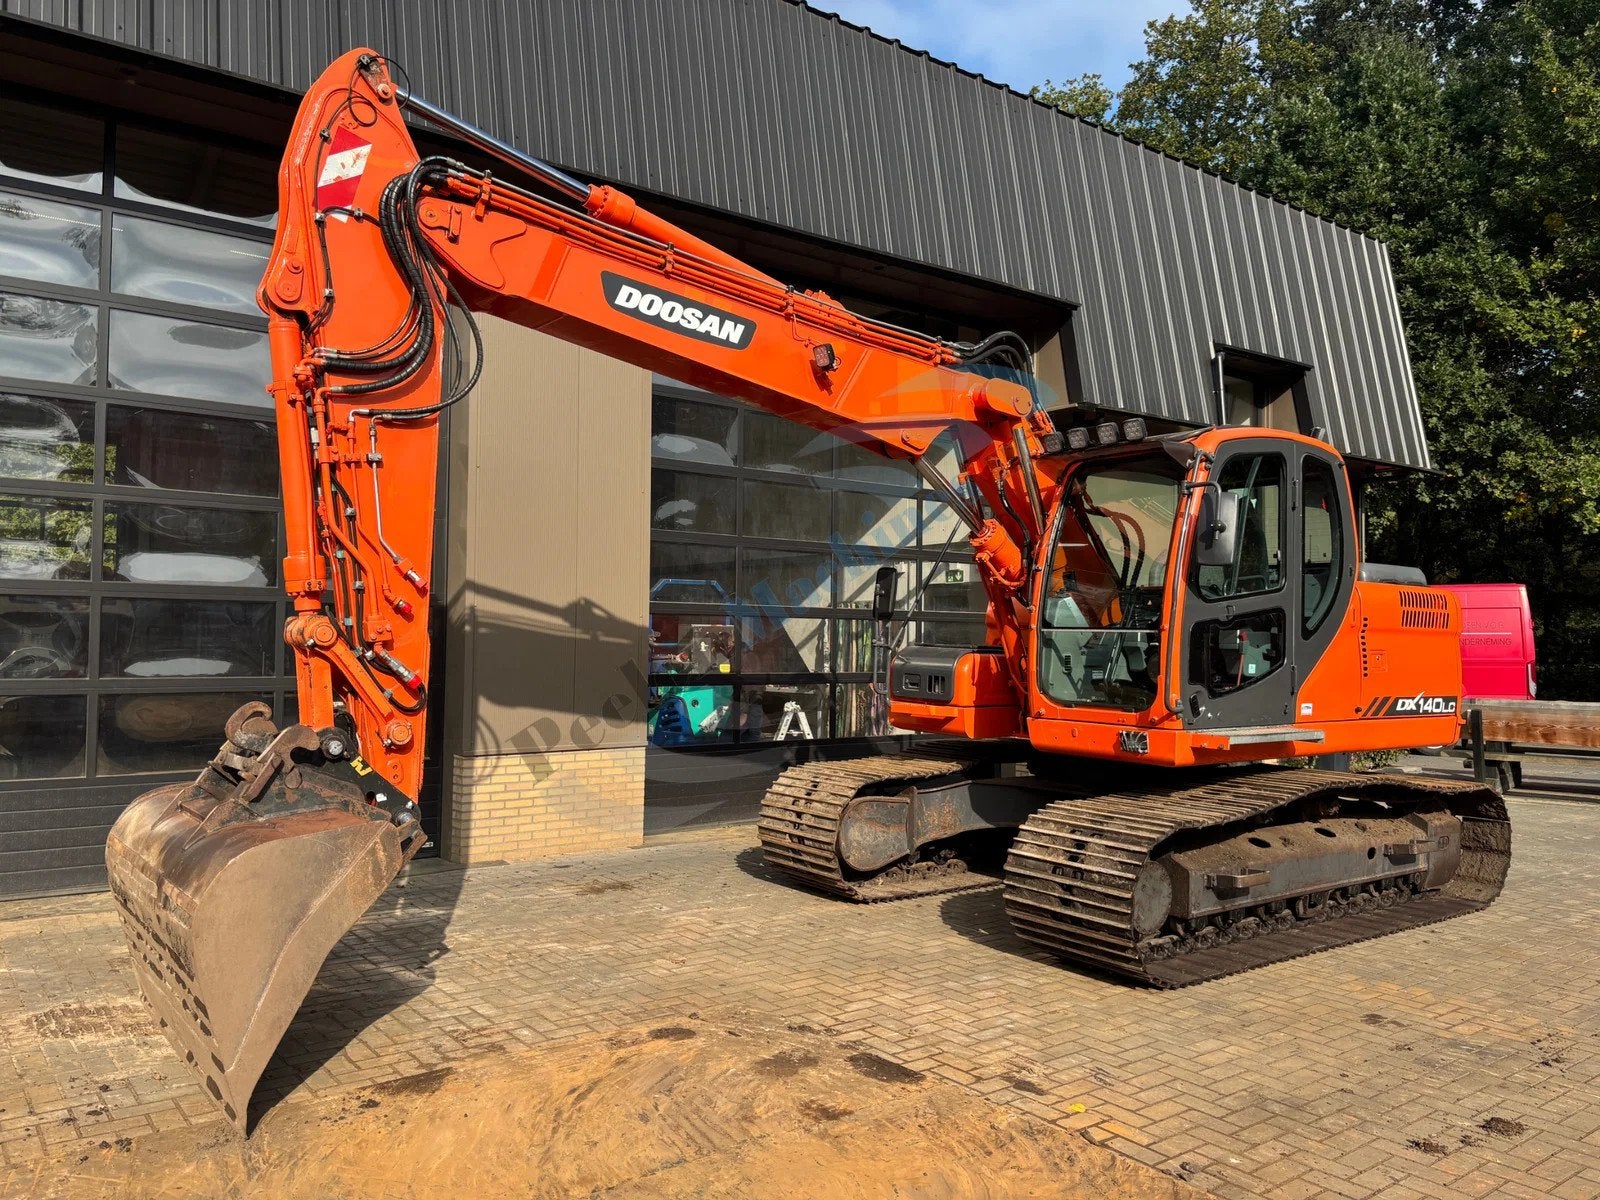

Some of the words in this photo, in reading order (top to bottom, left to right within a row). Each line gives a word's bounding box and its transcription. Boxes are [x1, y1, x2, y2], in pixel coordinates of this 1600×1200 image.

[614, 284, 745, 344] DOOSAN
[1459, 637, 1512, 646] NDERNEMING
[1396, 691, 1456, 713] DX140LC
